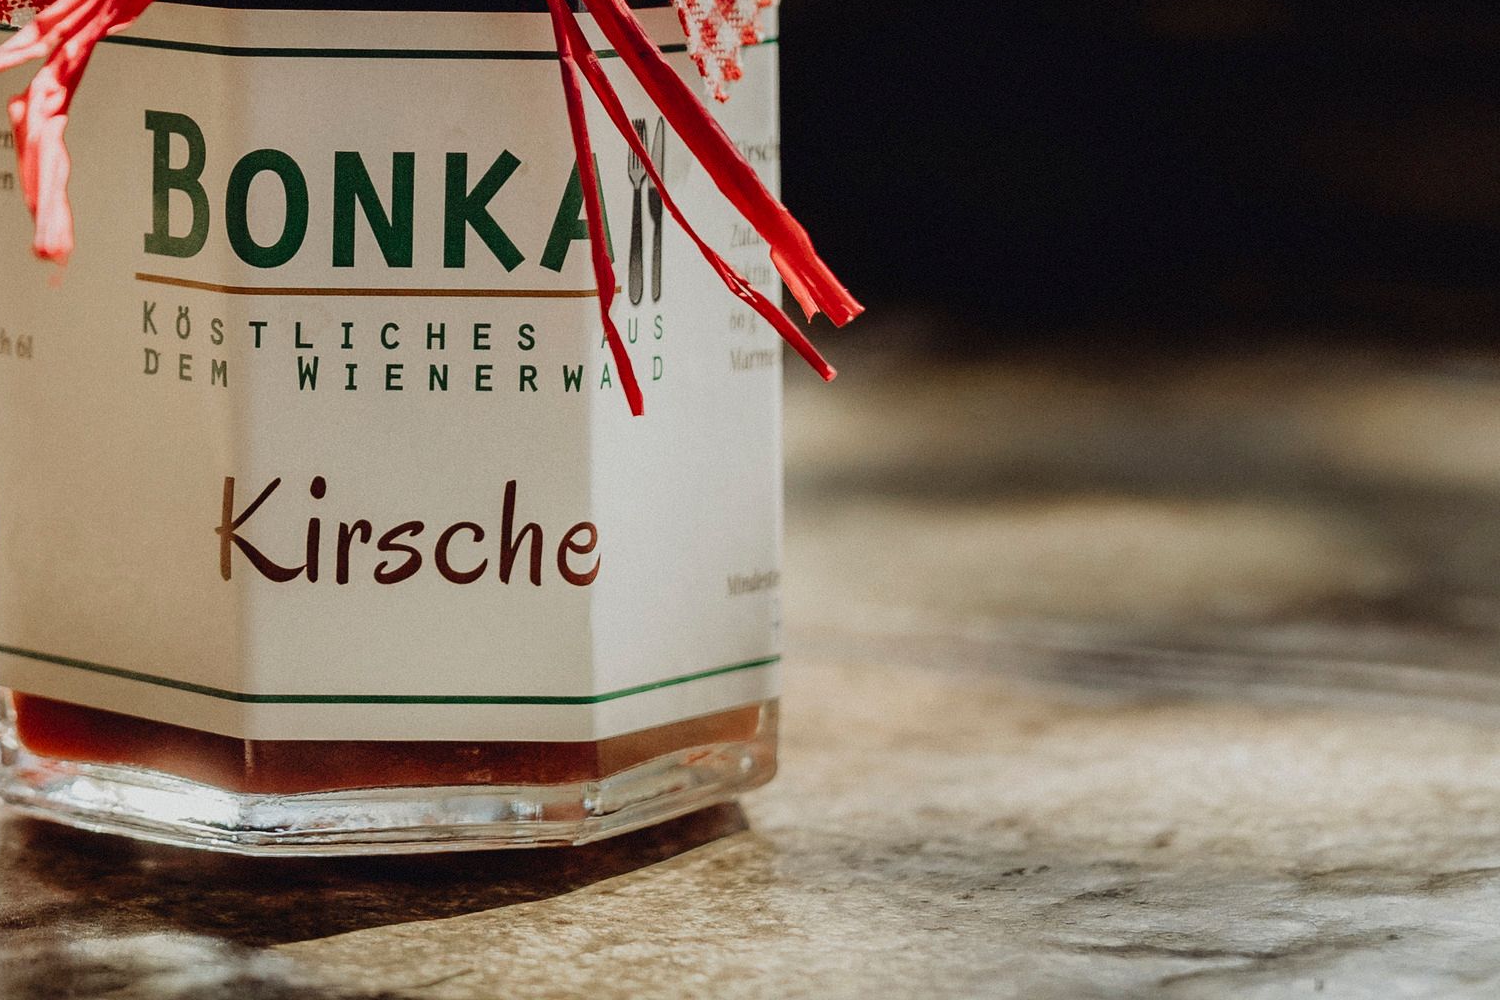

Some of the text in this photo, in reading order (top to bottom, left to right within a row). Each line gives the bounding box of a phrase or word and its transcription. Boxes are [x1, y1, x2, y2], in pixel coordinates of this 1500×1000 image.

[144, 108, 615, 272] BONKA
[143, 300, 536, 351] KÖSTLICHES
[143, 348, 663, 392] DEM WIENERWAD
[214, 475, 601, 586] Kirsche
